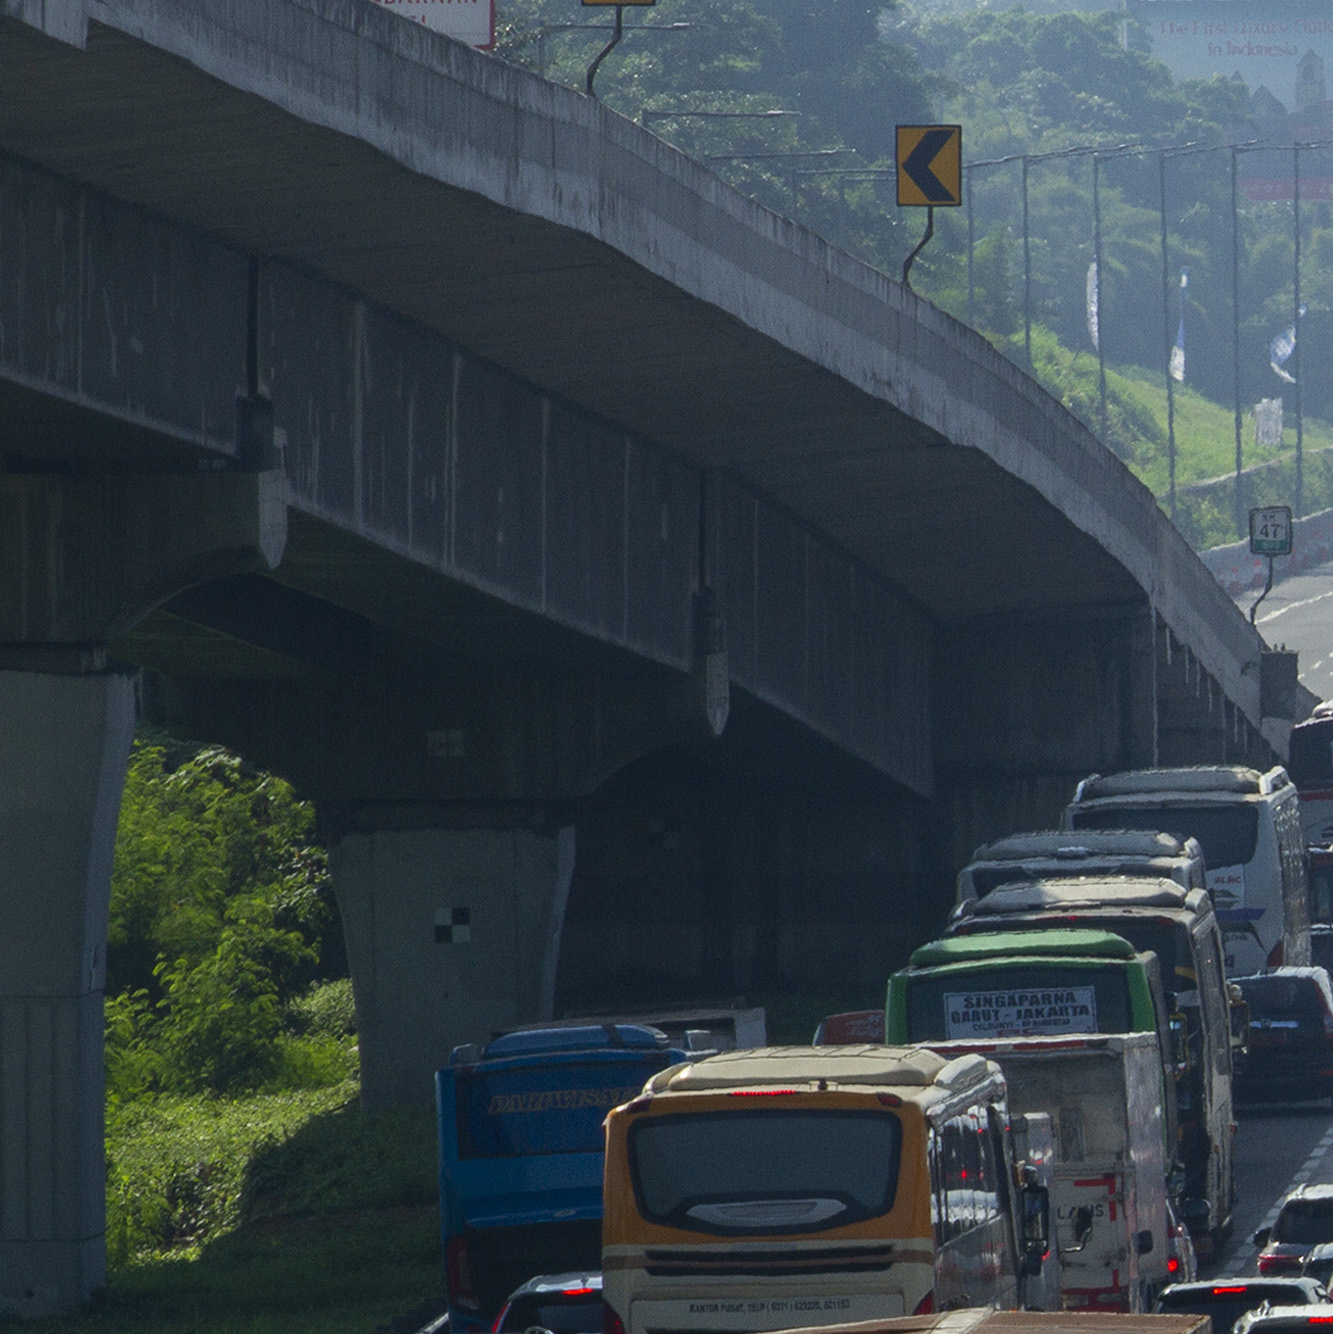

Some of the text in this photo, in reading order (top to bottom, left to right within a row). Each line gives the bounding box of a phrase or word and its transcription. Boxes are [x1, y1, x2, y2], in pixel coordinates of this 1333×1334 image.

[1259, 523, 1281, 539] 47
[963, 991, 1078, 1010] SINGAPARNA
[951, 1009, 1001, 1025] GARUT
[1016, 1004, 1090, 1021] JAKARTA
[689, 1303, 720, 1313] KANTOR
